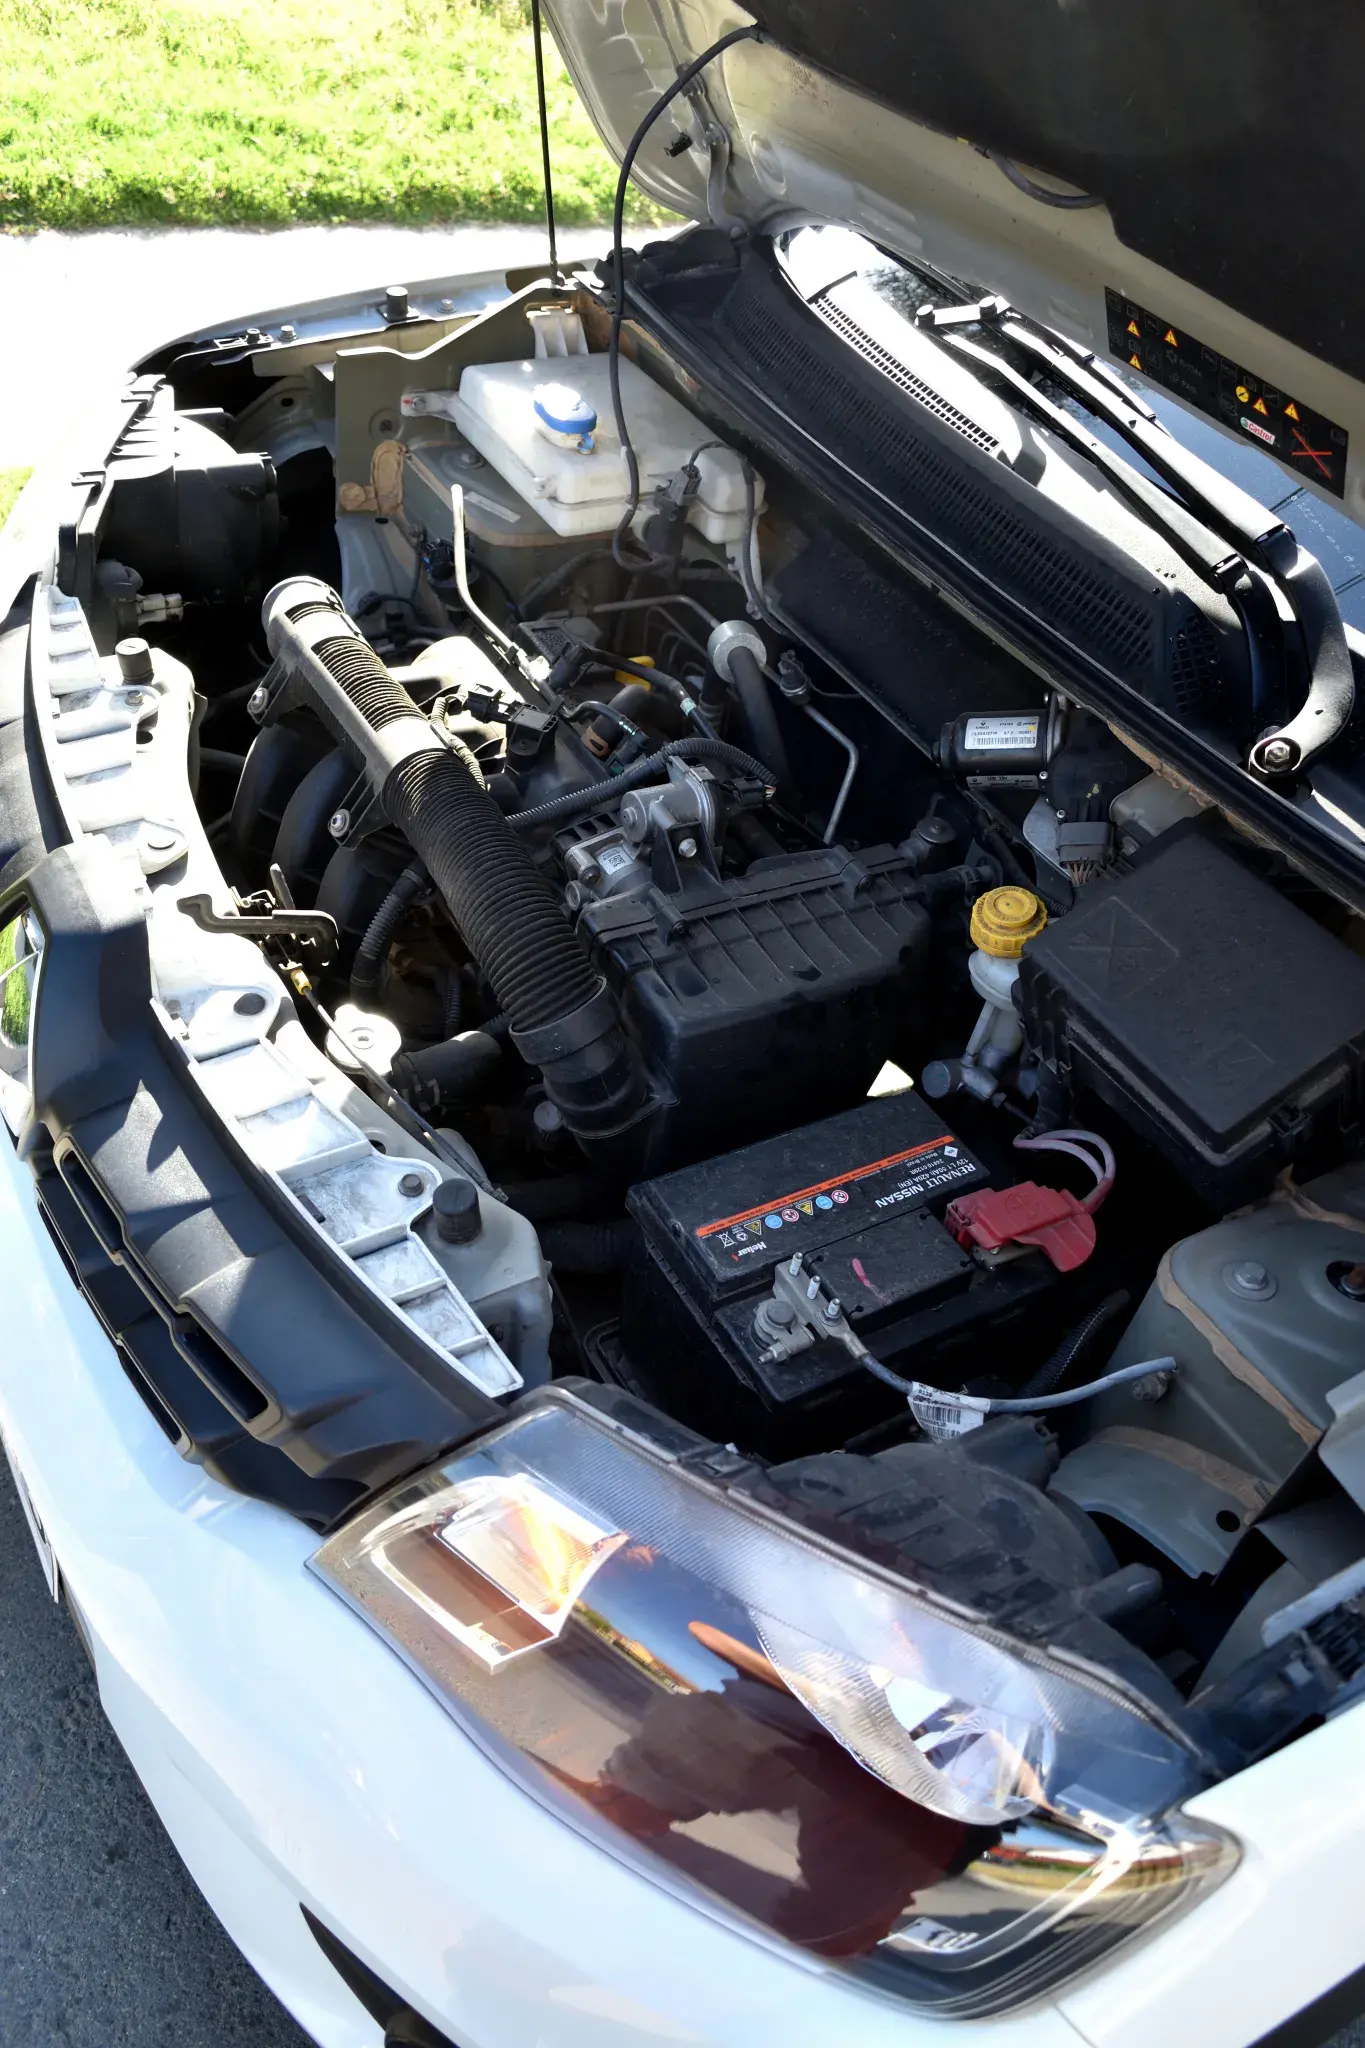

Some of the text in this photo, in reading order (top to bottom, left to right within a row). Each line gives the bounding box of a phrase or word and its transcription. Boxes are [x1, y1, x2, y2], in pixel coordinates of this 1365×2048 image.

[1248, 423, 1272, 442] Castrol
[956, 1158, 969, 1166] 12V
[926, 1163, 976, 1189] RENAULT
[875, 1183, 924, 1208] NISSAN
